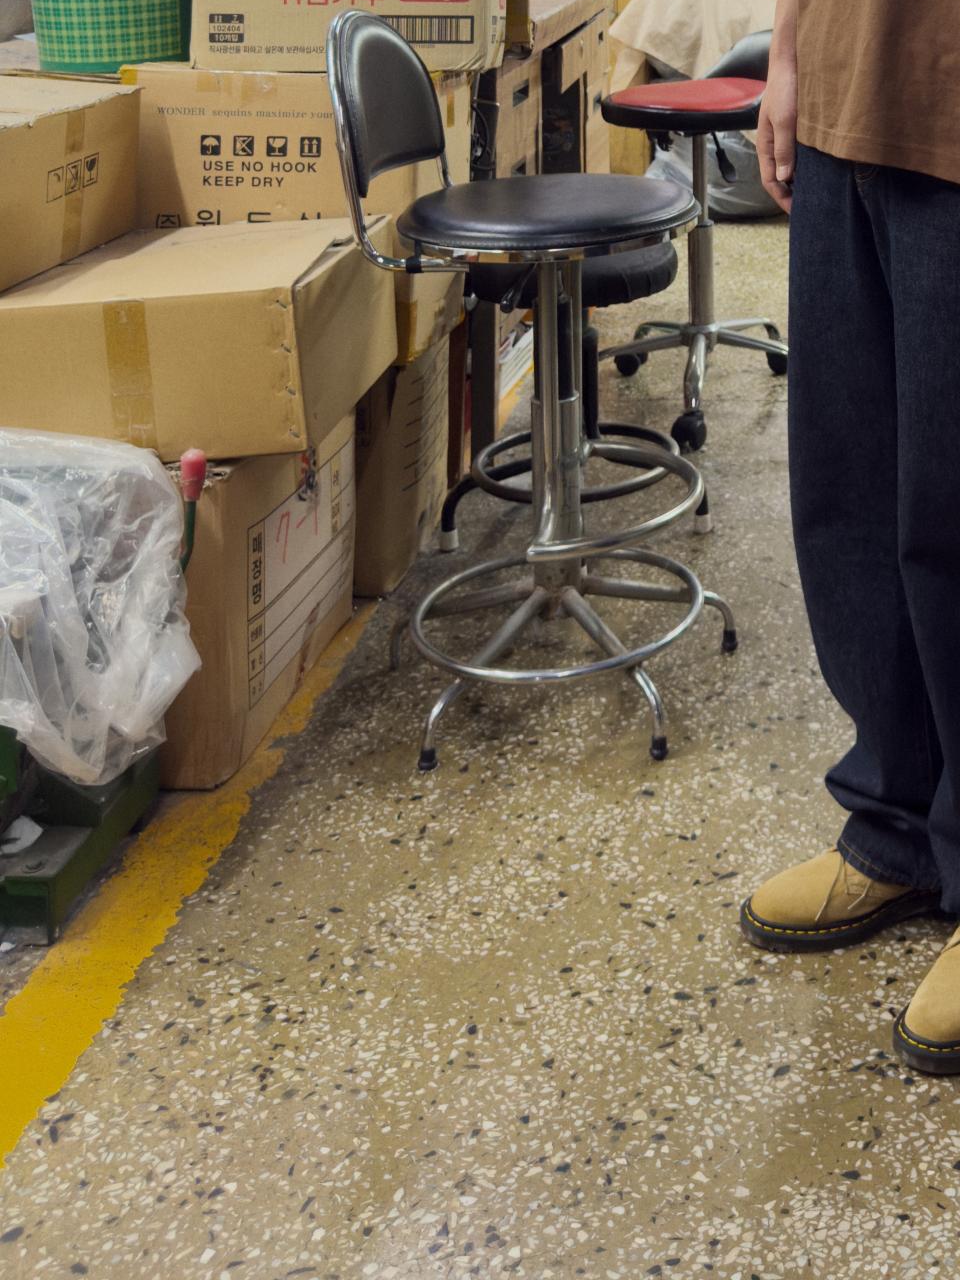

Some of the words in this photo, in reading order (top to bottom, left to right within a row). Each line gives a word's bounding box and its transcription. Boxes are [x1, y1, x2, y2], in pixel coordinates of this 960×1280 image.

[256, 108, 307, 119] maximize
[203, 160, 234, 172] USE
[241, 161, 264, 173] NO
[270, 161, 318, 173] HOOK
[202, 175, 245, 187] KEEP
[251, 176, 285, 188] DRY
